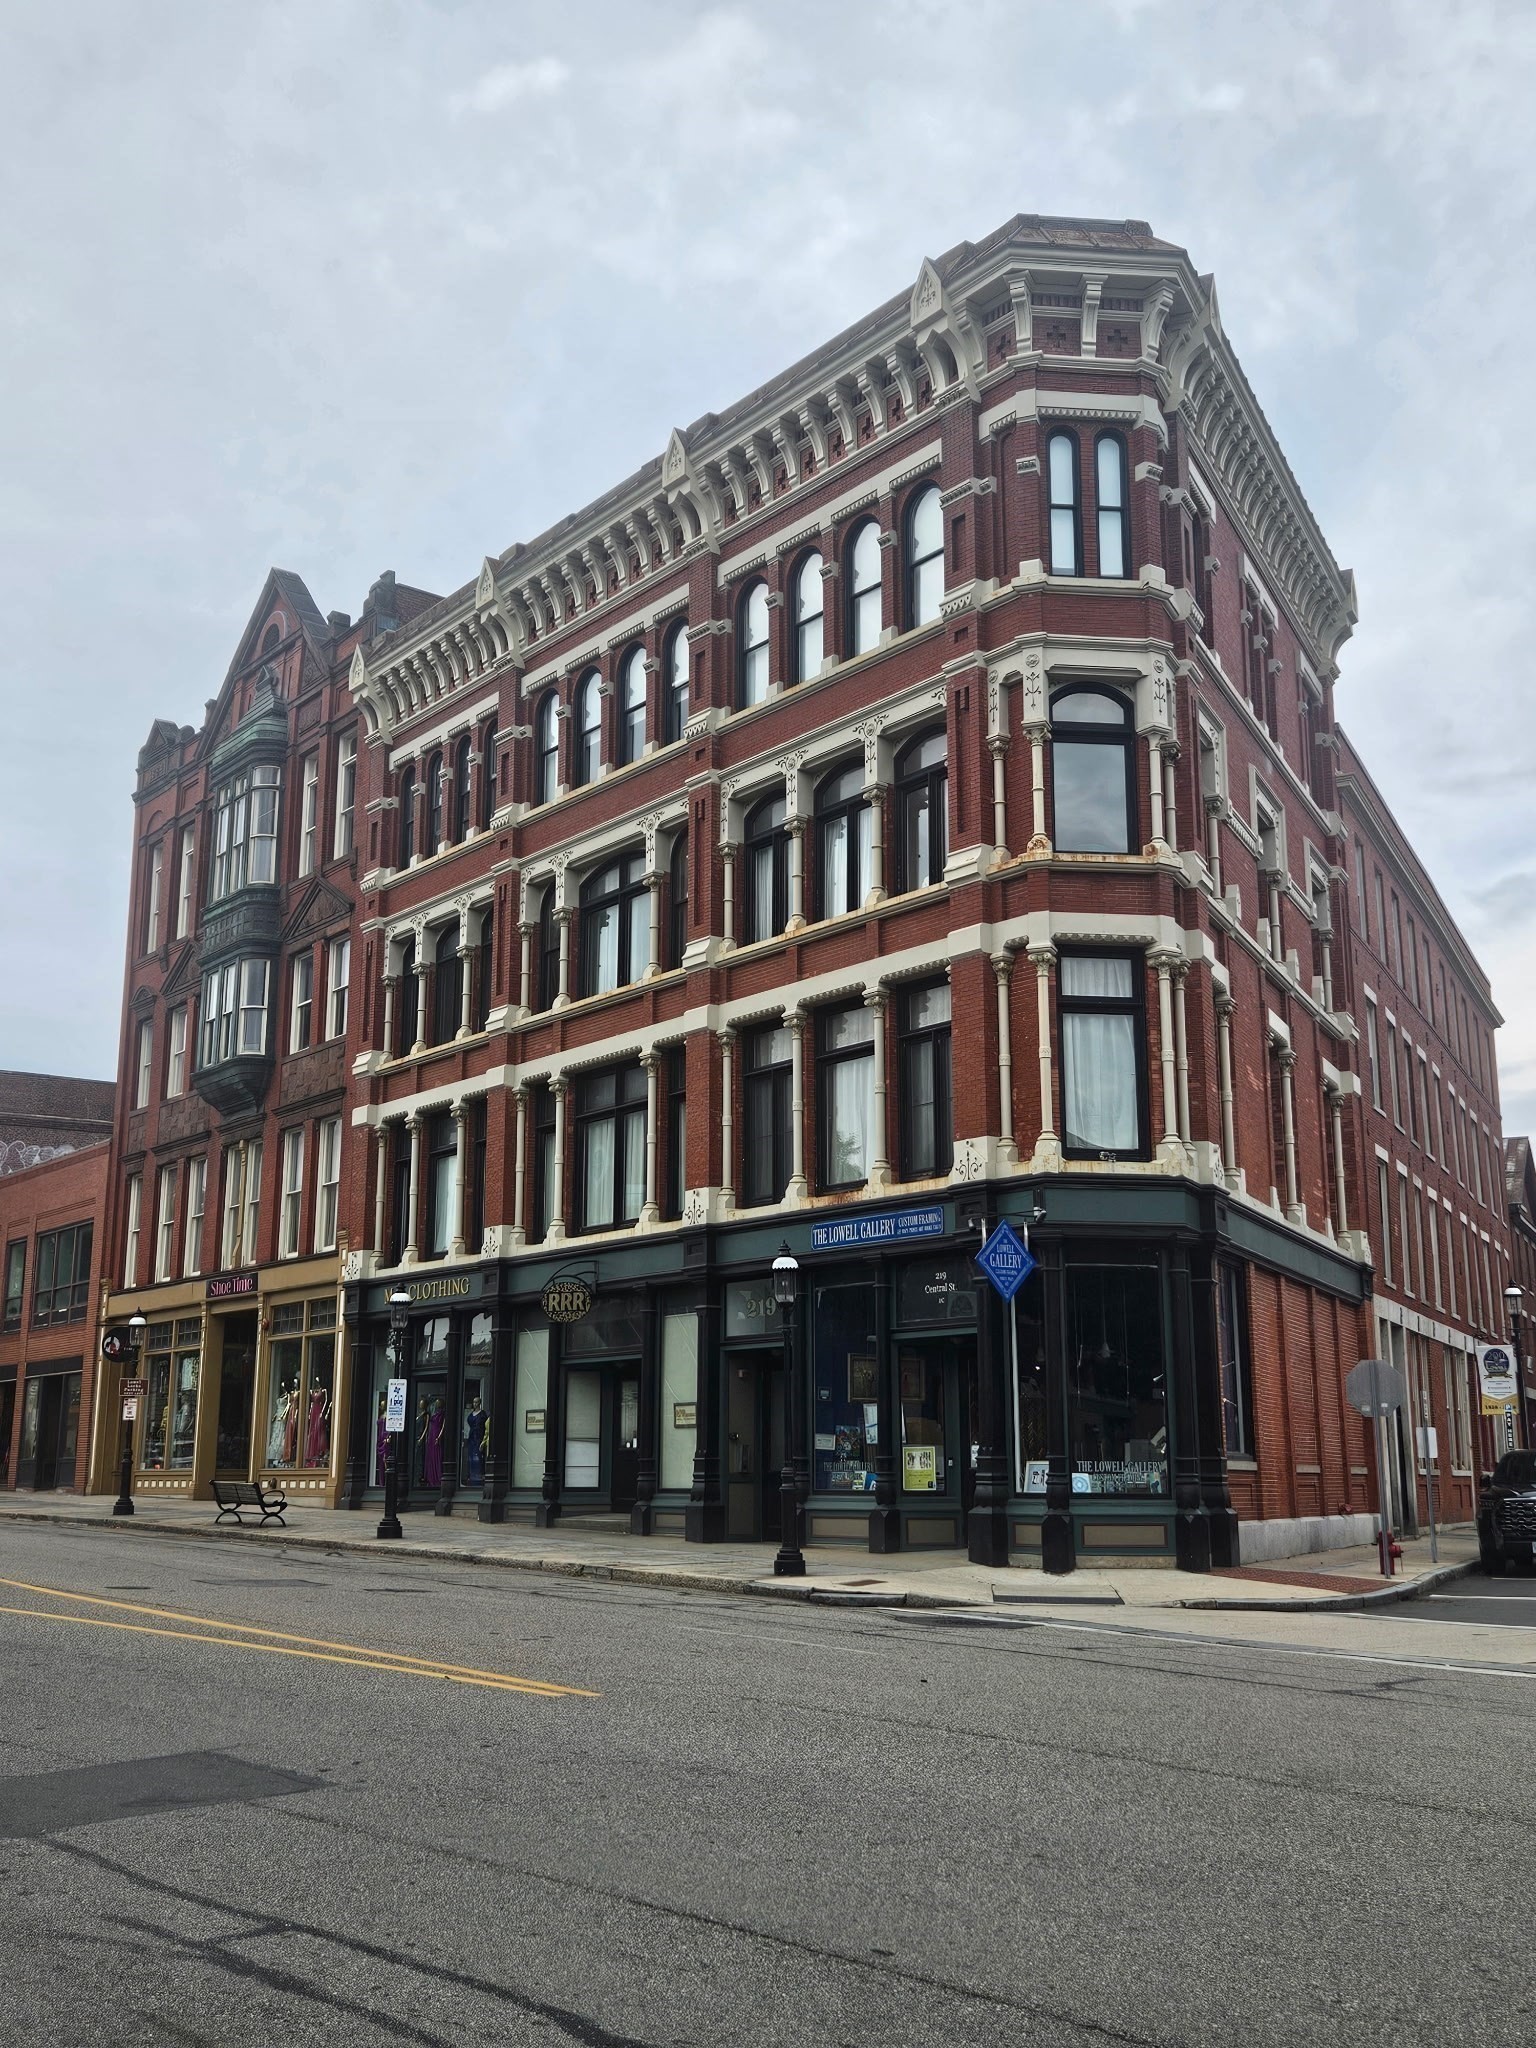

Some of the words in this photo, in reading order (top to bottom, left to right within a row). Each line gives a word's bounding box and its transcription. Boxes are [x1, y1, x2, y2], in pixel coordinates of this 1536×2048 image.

[898, 1214, 918, 1228] CUSTOM
[813, 1228, 828, 1246] THE
[829, 1223, 859, 1243] LOWELL
[860, 1218, 896, 1239] GALLERY
[996, 1243, 1015, 1254] LOWELL
[990, 1253, 1022, 1268] GALLERY
[935, 1271, 947, 1280] 219
[210, 1281, 231, 1296] Shoe
[232, 1276, 253, 1292] Time
[408, 1277, 470, 1301] CLOTHING
[924, 1282, 948, 1294] Central
[548, 1292, 585, 1311] RRR
[747, 1296, 776, 1319] 219
[1076, 1460, 1093, 1473] THE
[1094, 1460, 1126, 1473] LOWELL
[1126, 1460, 1163, 1473] GALLERY
